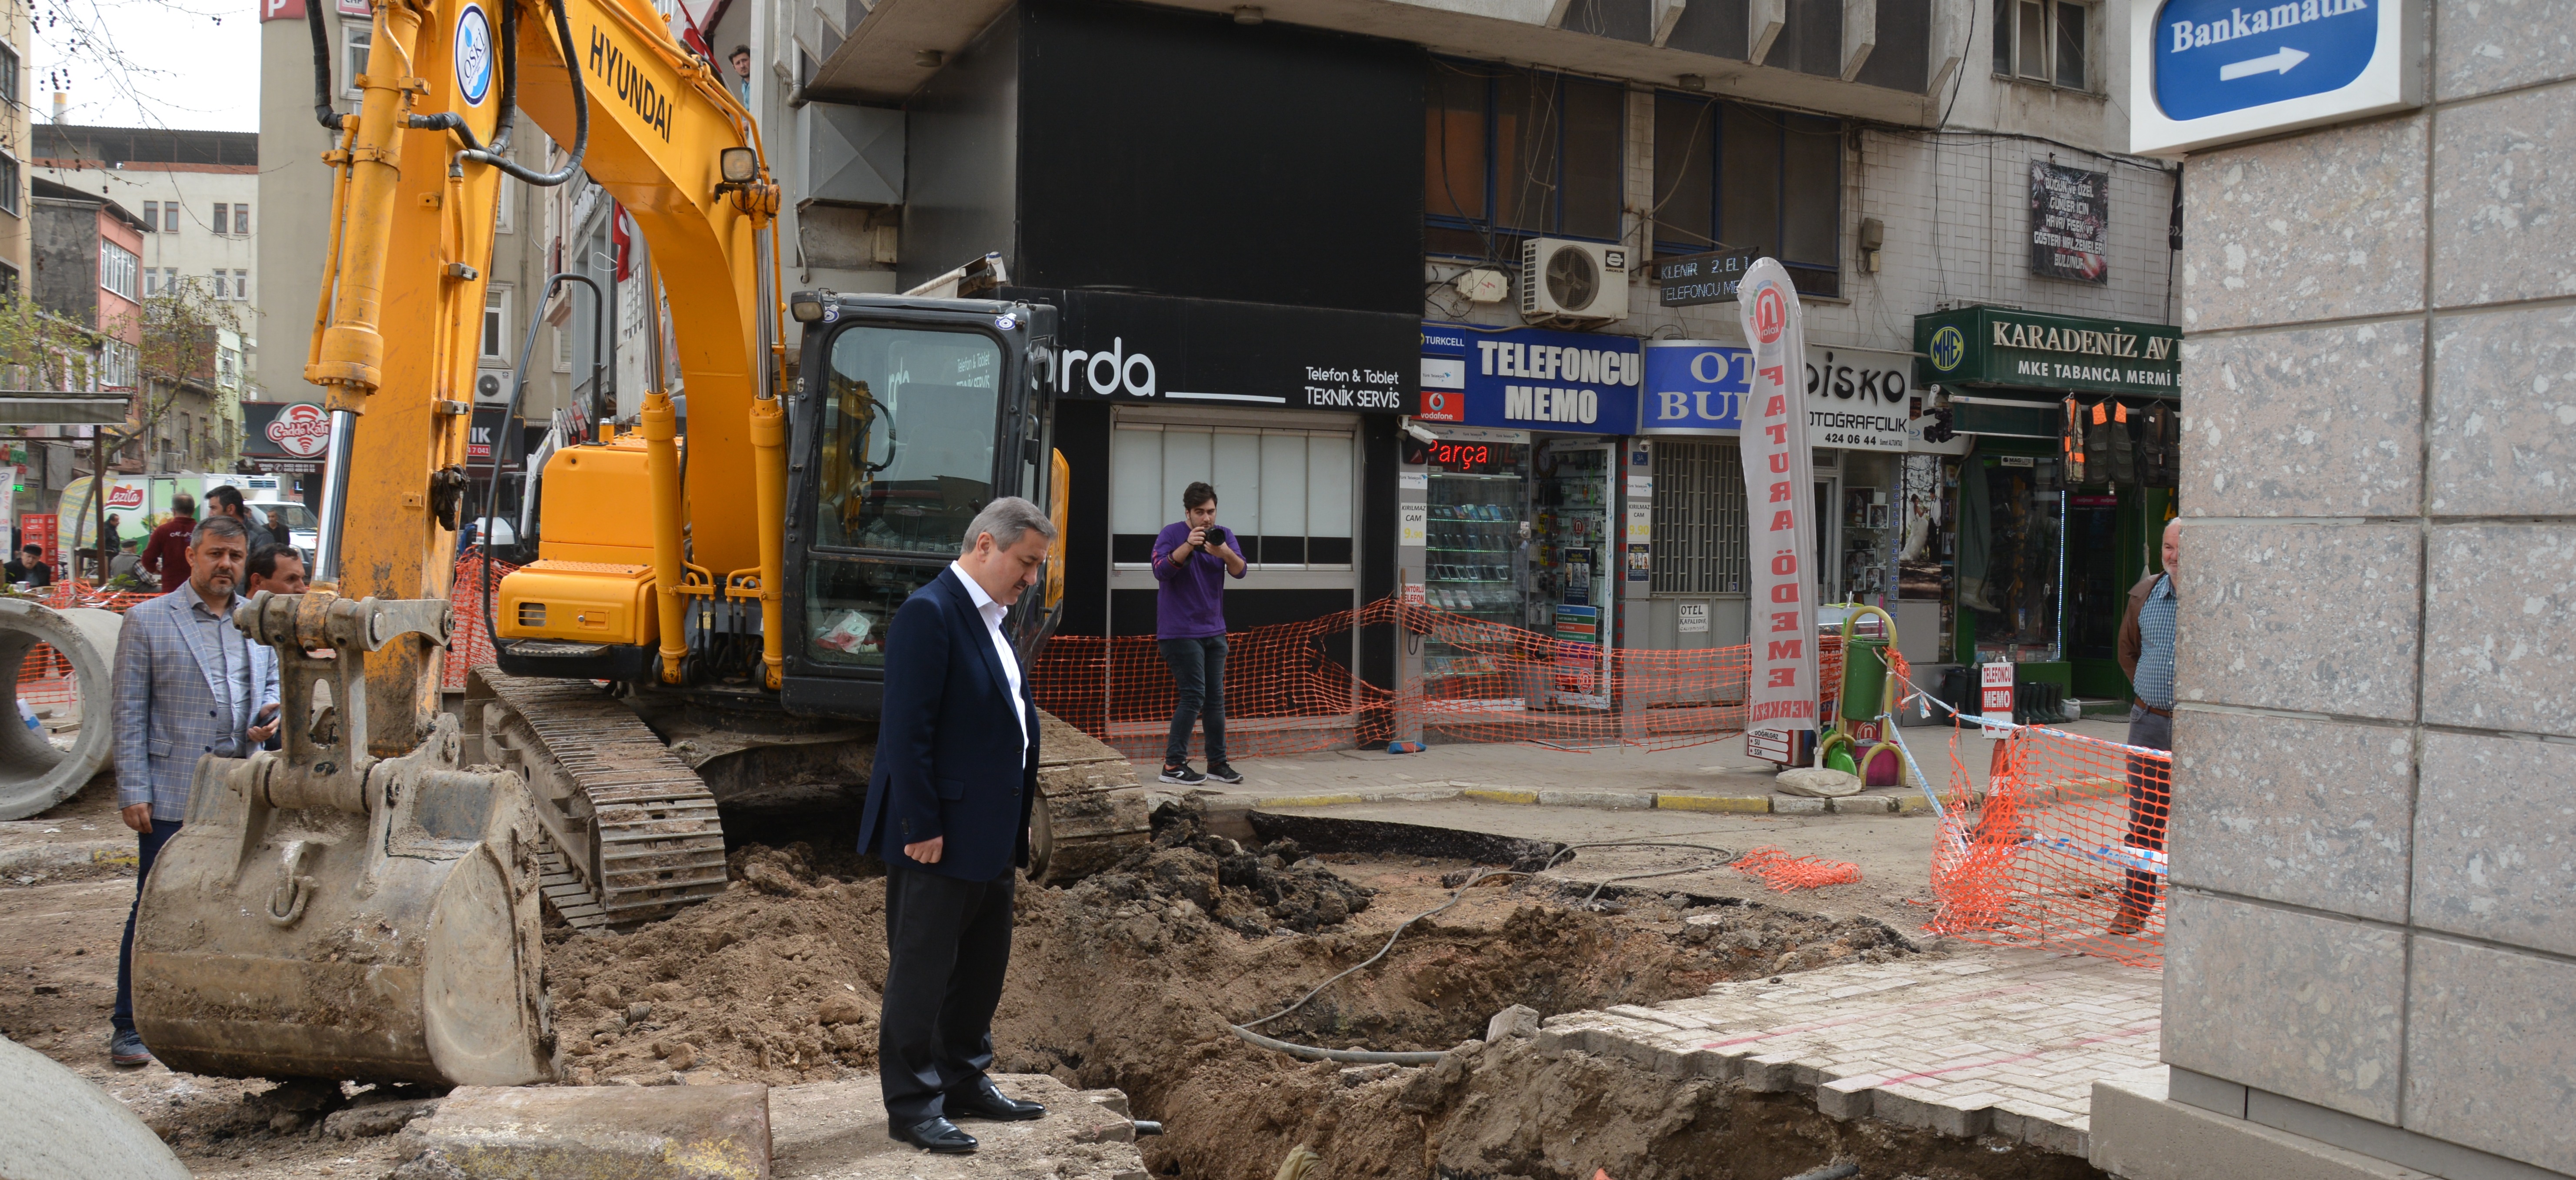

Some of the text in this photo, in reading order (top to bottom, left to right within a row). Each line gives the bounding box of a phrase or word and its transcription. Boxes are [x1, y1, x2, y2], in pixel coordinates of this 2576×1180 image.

[590, 24, 672, 144] HYUNDAI
[2068, 184, 2076, 194] ve
[2078, 181, 2093, 198] ÖZEL
[2049, 195, 2075, 213] GÜNLER
[2086, 224, 2093, 235] ve
[2034, 231, 2105, 256] GÖSTERİ MALZEMELERİ
[2054, 253, 2085, 270] BULUNUR
[1660, 282, 1721, 301] TELEFONCU
[1425, 335, 1465, 347] TURKCELL
[1992, 321, 2173, 360] KARADENİZ AV
[1477, 340, 1640, 386] TELEFONCU
[1306, 366, 1399, 384] Telefon & Tablet
[2018, 360, 2171, 386] MKE TABANCA MERMİ
[1305, 384, 1400, 408] TEKNİK SERVİS
[1504, 385, 1598, 424] MEMO
[1809, 411, 1908, 433] TOĞRAFÇILIK
[1825, 433, 1844, 443] 424
[1847, 434, 1860, 444] 06
[1863, 436, 1876, 445] 44
[107, 489, 140, 503] Lezita
[1404, 527, 1423, 539] 9.90
[1629, 525, 1650, 535] 9.90
[1890, 538, 1899, 618] VESİKALIK
[1401, 585, 1425, 593] ONTÖRLÜ
[1401, 594, 1424, 602] ELEFON
[1681, 605, 1703, 615] OTEL
[1983, 666, 2011, 683] TELEFONCU
[1984, 690, 2010, 708] MEMO
[1755, 730, 1779, 740] DOĞALGAZ
